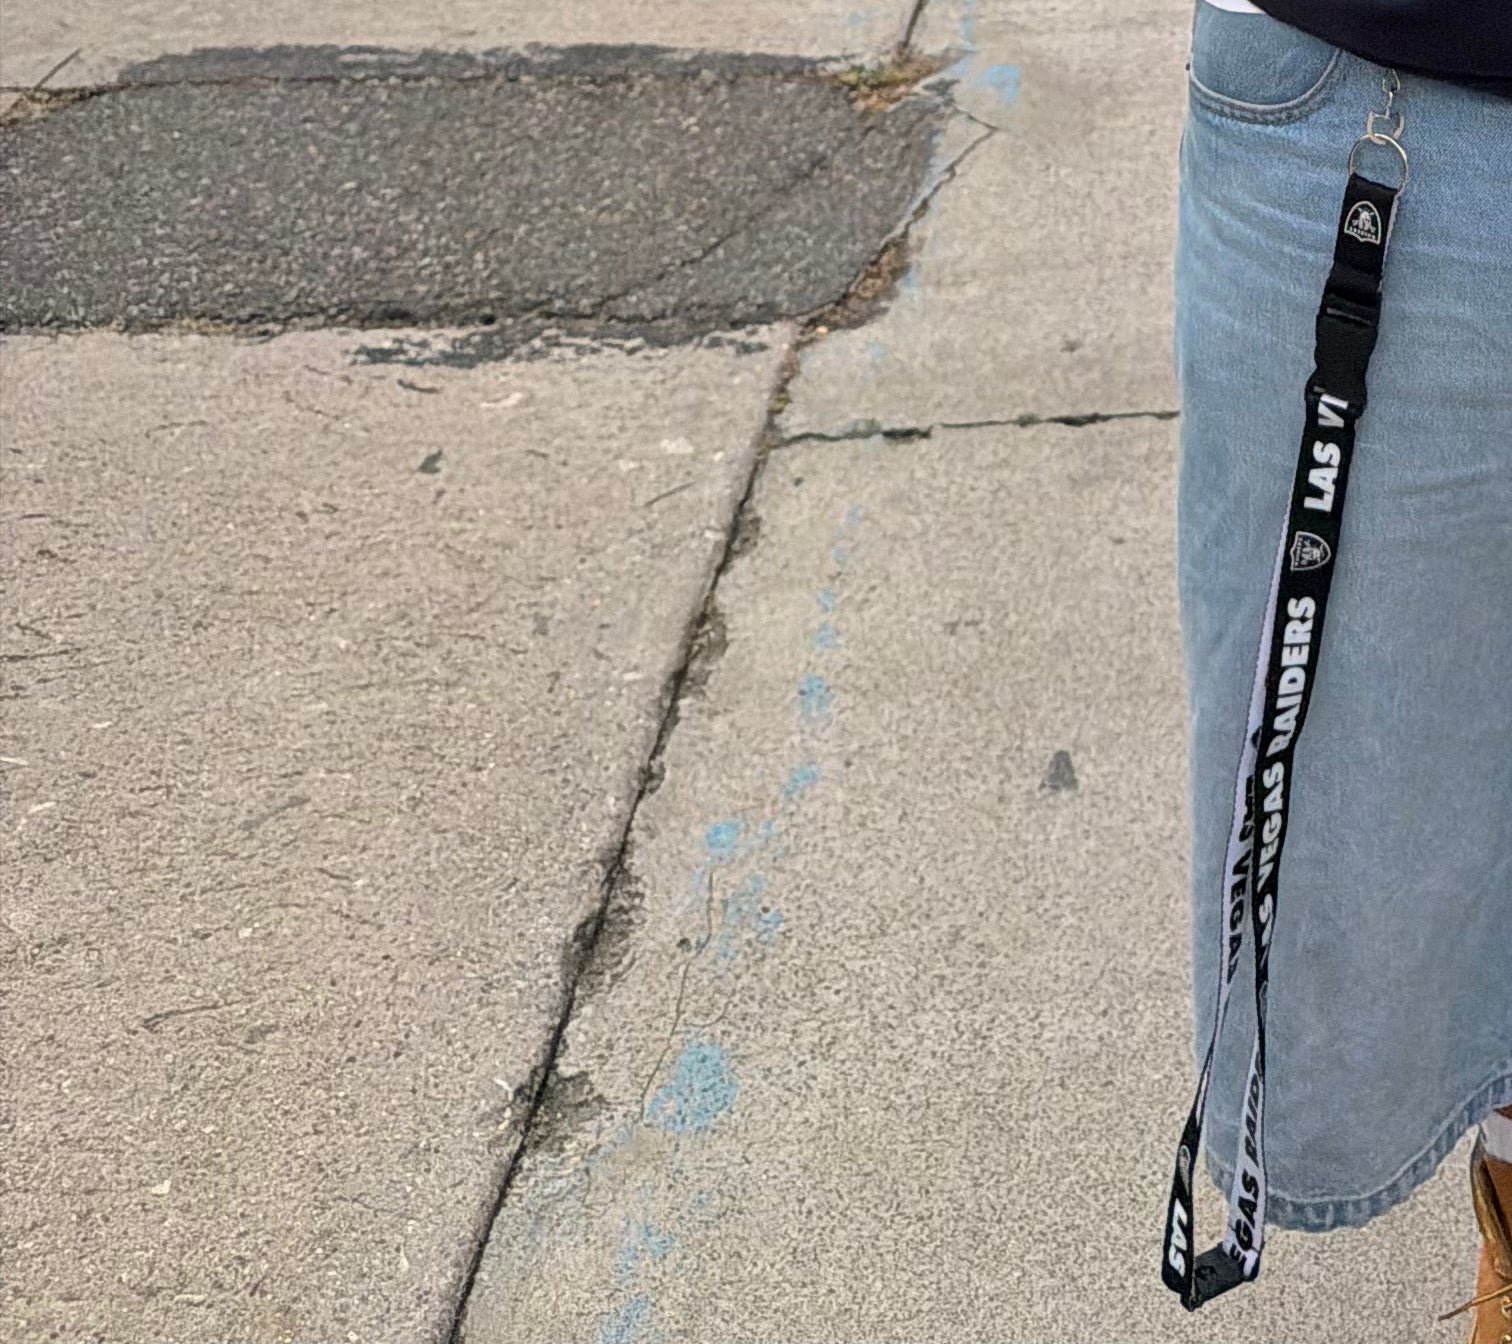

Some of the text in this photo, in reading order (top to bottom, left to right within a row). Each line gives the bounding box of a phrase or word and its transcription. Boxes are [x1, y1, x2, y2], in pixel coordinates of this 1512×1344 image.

[1303, 440, 1341, 512] LAS
[1266, 596, 1317, 758] RAIDERS
[1256, 761, 1286, 892] VEGAS
[1169, 1197, 1188, 1278] LAS
